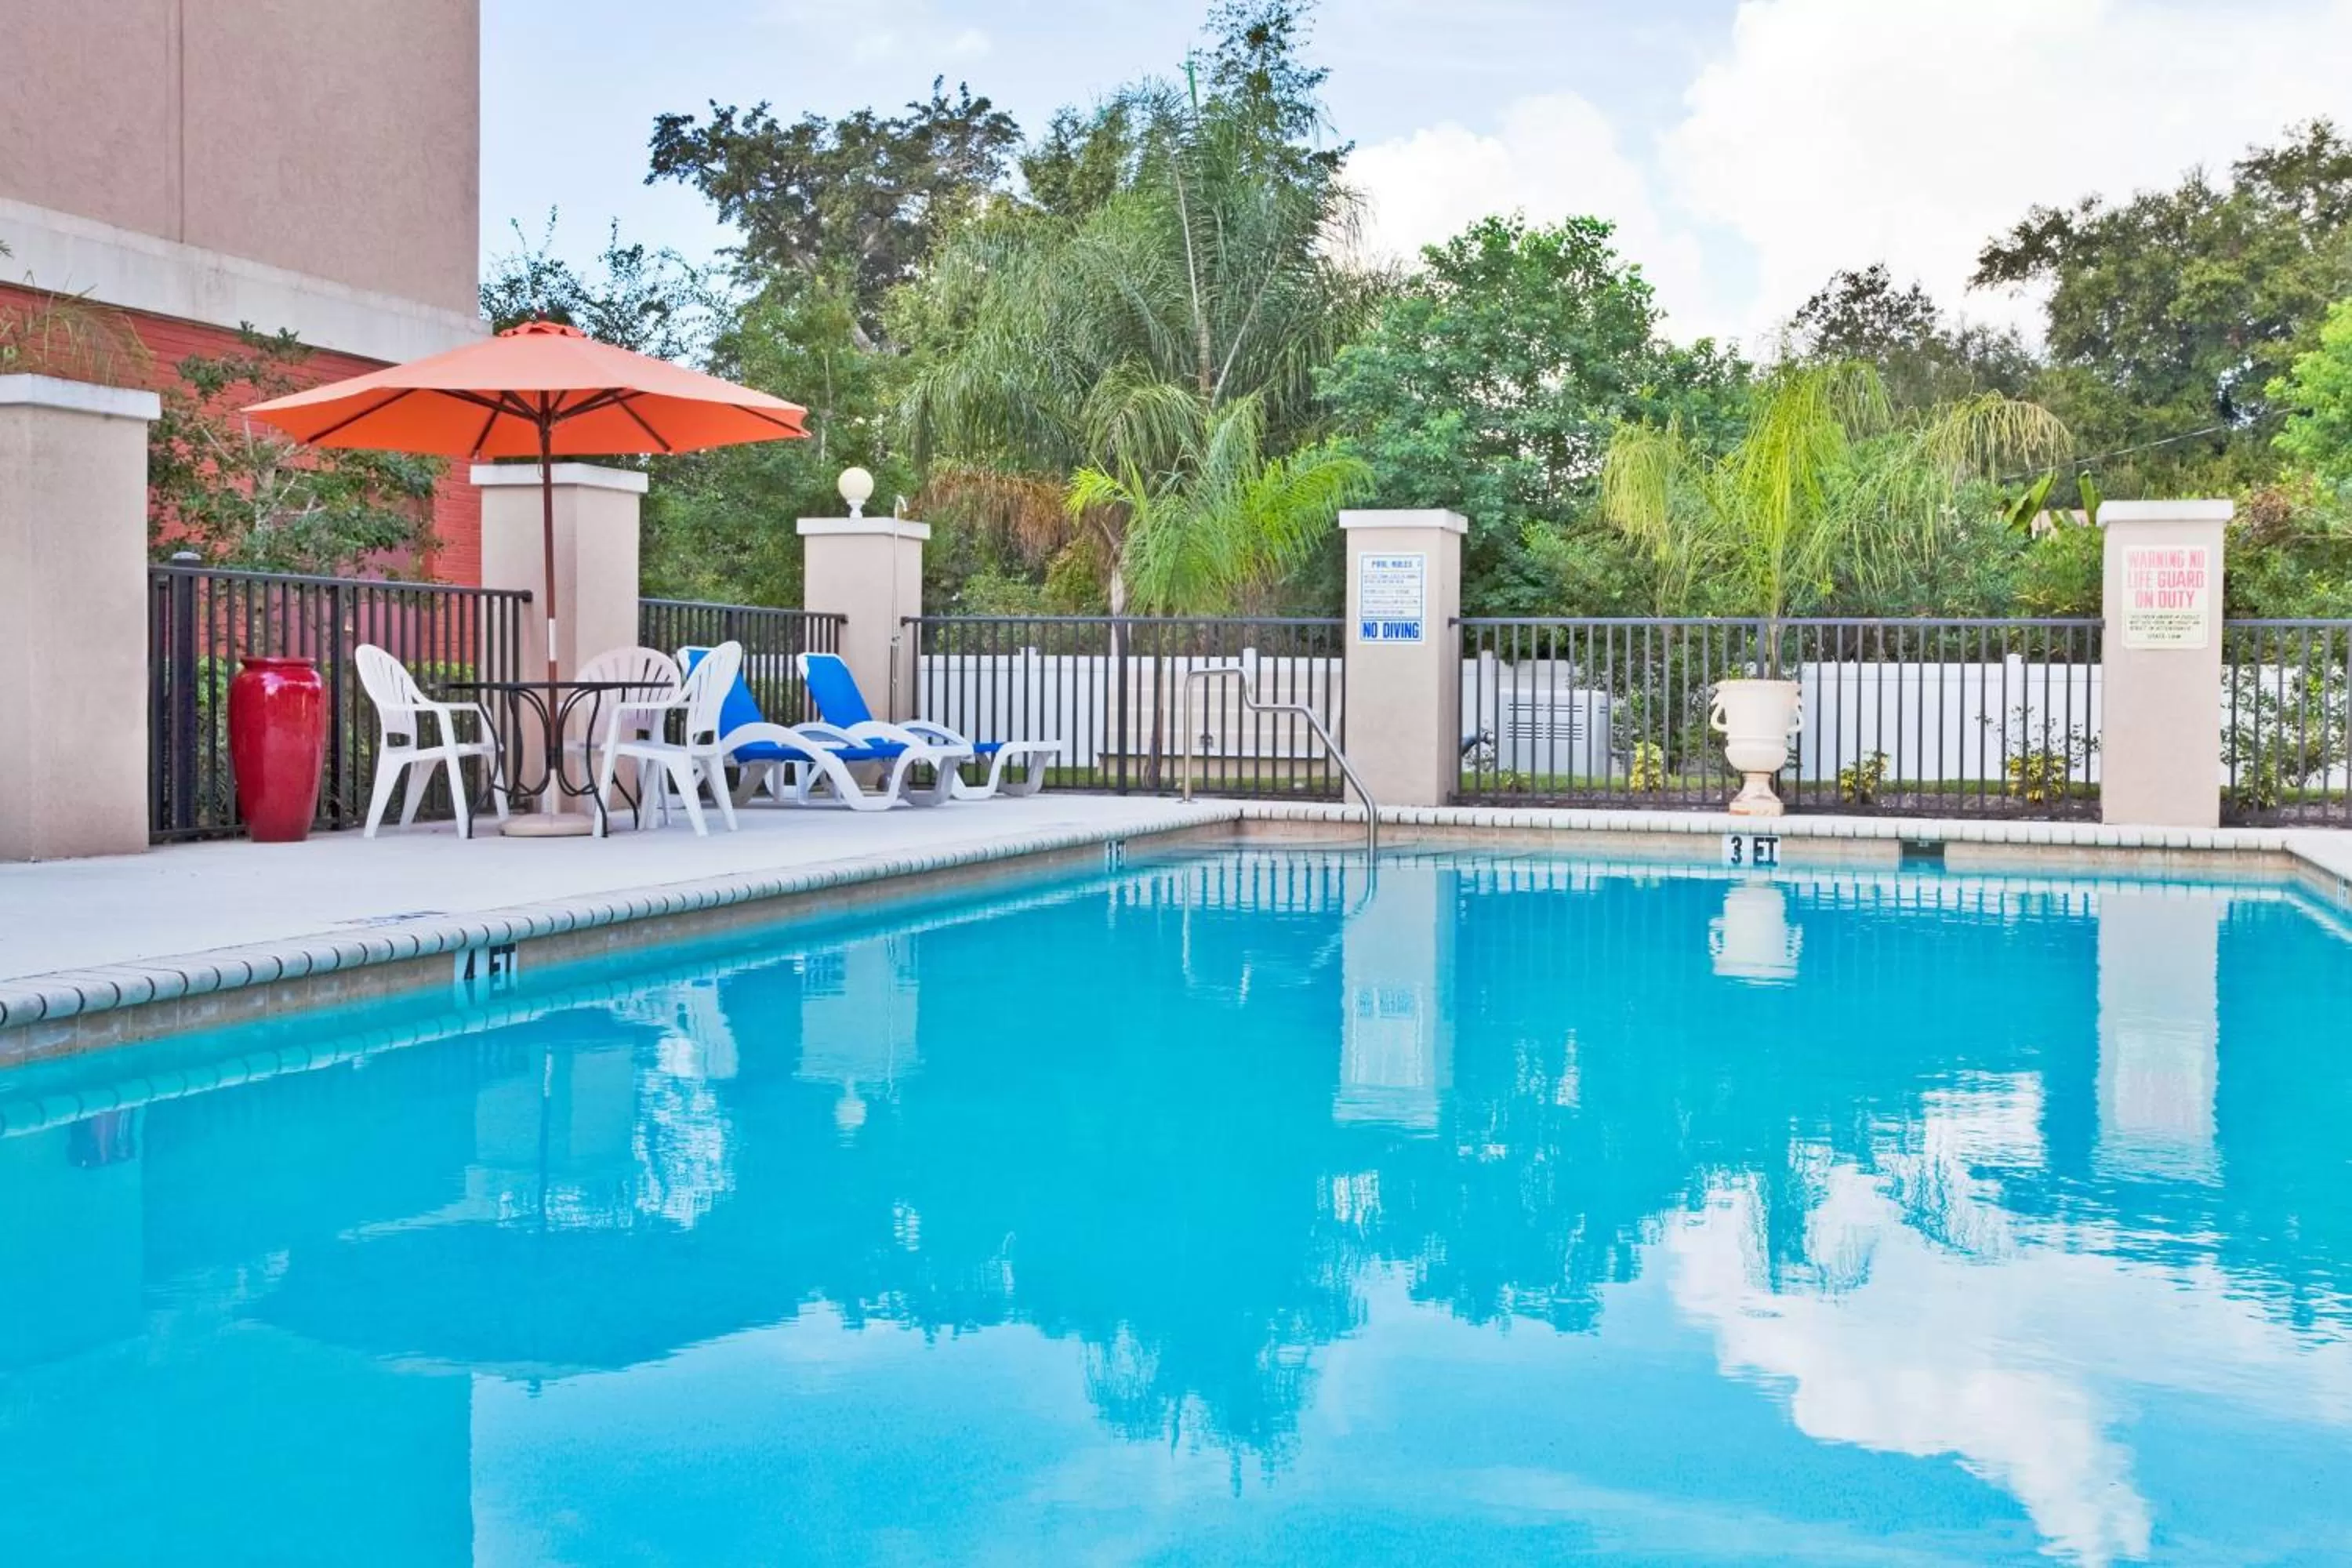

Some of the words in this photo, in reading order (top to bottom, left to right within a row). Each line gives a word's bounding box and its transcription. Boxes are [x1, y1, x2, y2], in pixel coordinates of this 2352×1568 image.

[2127, 550, 2185, 568] WARNING
[2189, 550, 2205, 568] NO
[2127, 570, 2152, 588] LIFE
[2157, 570, 2205, 589] GUARD
[2135, 589, 2154, 608] ON
[2158, 589, 2194, 608] DUTY
[1363, 622, 1377, 638] NO
[1382, 622, 1420, 638] DIVING
[1730, 836, 1742, 864] 3
[488, 943, 516, 977] FT
